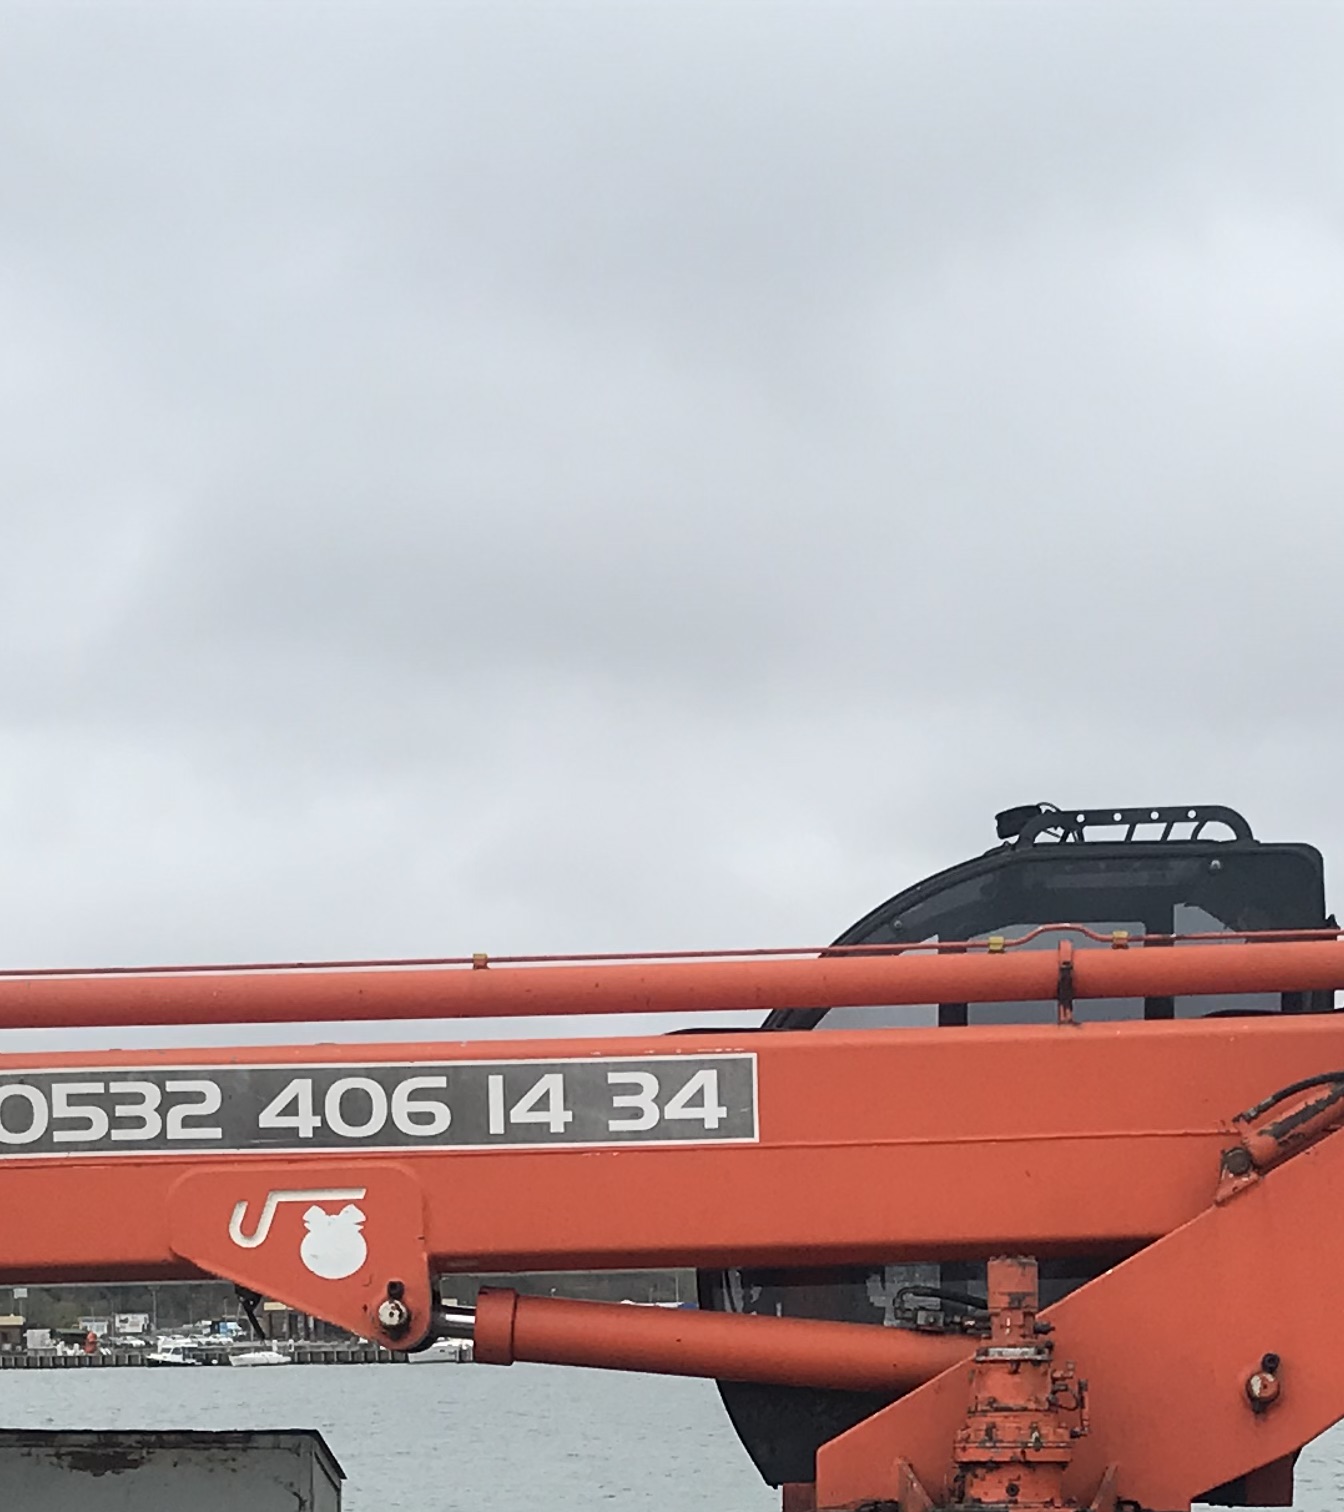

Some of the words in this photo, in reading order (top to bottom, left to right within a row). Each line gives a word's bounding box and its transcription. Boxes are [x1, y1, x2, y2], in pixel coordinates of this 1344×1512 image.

[258, 1076, 453, 1138] 406
[488, 1073, 574, 1135] 14
[607, 1068, 729, 1132] 34
